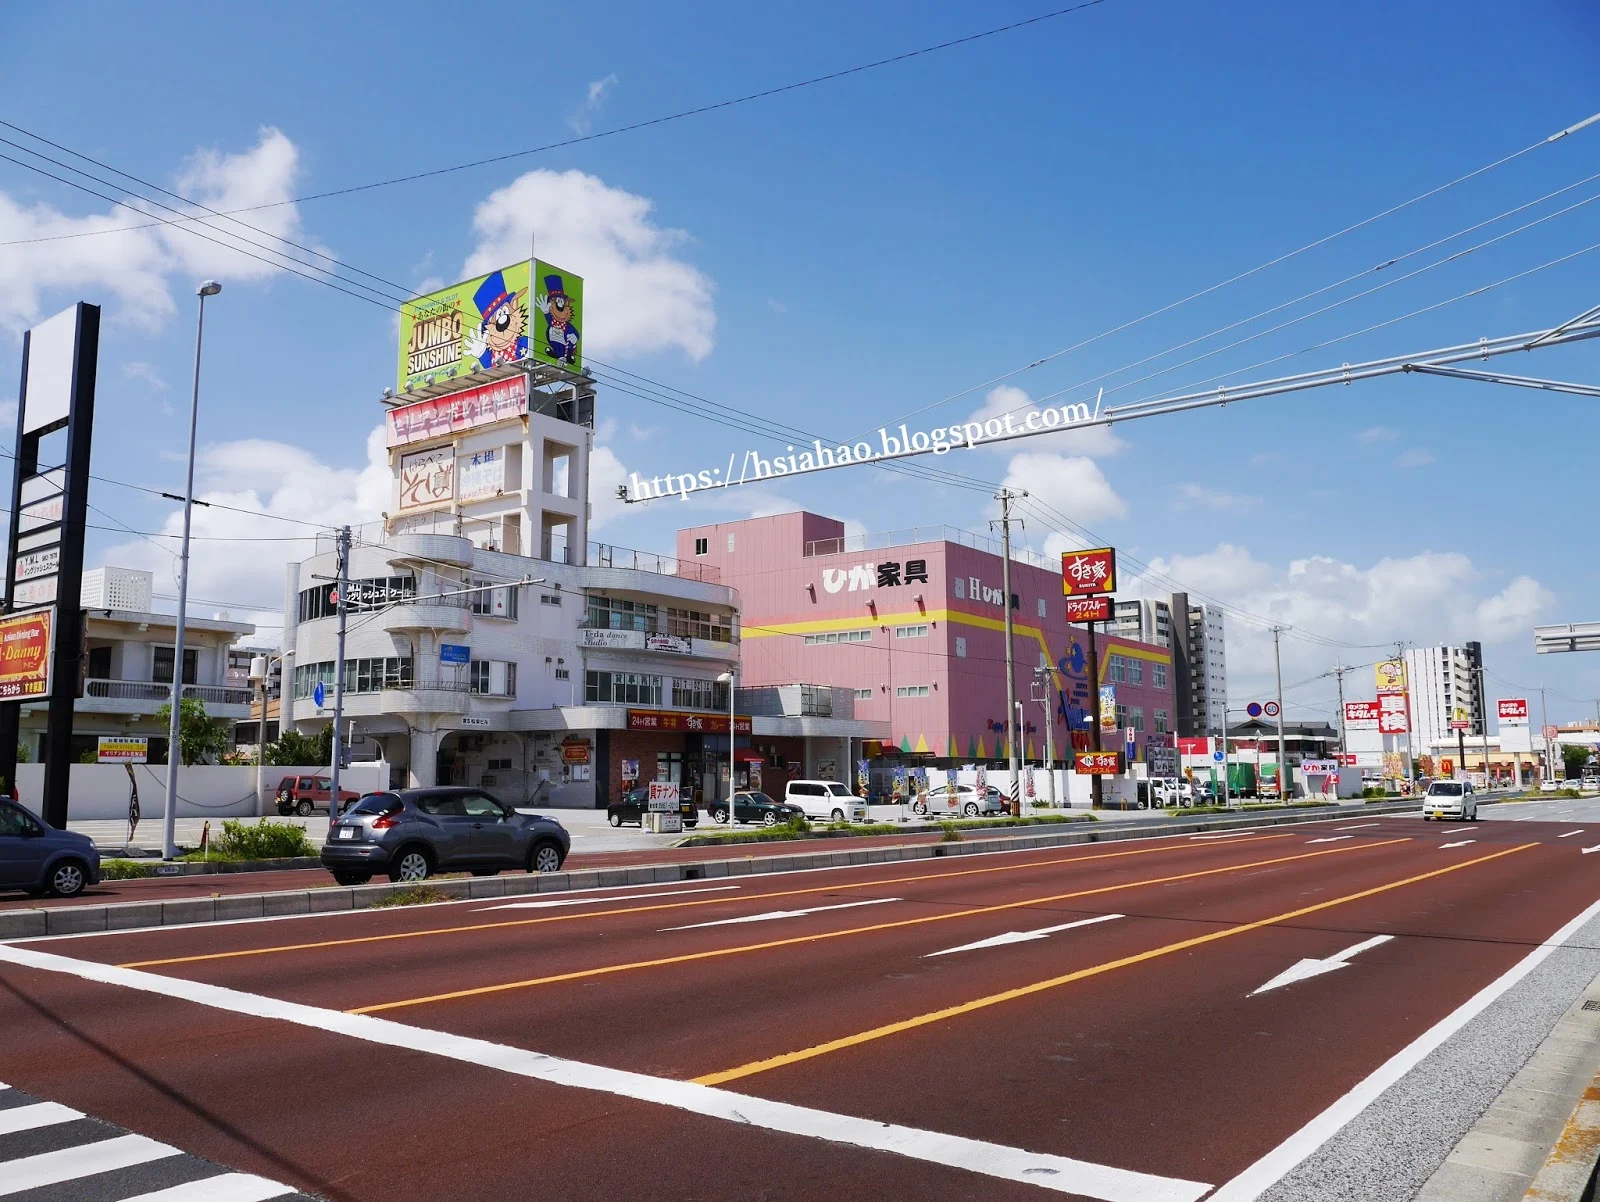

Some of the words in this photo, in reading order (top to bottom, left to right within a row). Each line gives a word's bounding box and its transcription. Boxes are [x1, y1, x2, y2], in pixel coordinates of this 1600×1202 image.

[408, 309, 463, 354] JUMBO
[408, 341, 462, 376] SUNSHINE
[470, 449, 495, 467] 本場
[822, 559, 928, 594] ひが家具
[1068, 555, 1107, 582] すき家
[1067, 600, 1107, 612] ドライブスルー
[4, 633, 17, 642] Asian
[17, 630, 30, 640] Dining
[31, 629, 40, 637] Bar
[584, 638, 608, 646] studio
[1347, 710, 1378, 719] キタムラ
[1380, 695, 1406, 731] 車検
[1500, 707, 1525, 715] キタムラ
[632, 716, 657, 727] 24H営業
[686, 714, 703, 731] すき家
[711, 721, 725, 730] カレー
[1096, 754, 1115, 766] すき家
[650, 784, 678, 799] 貸テナント
